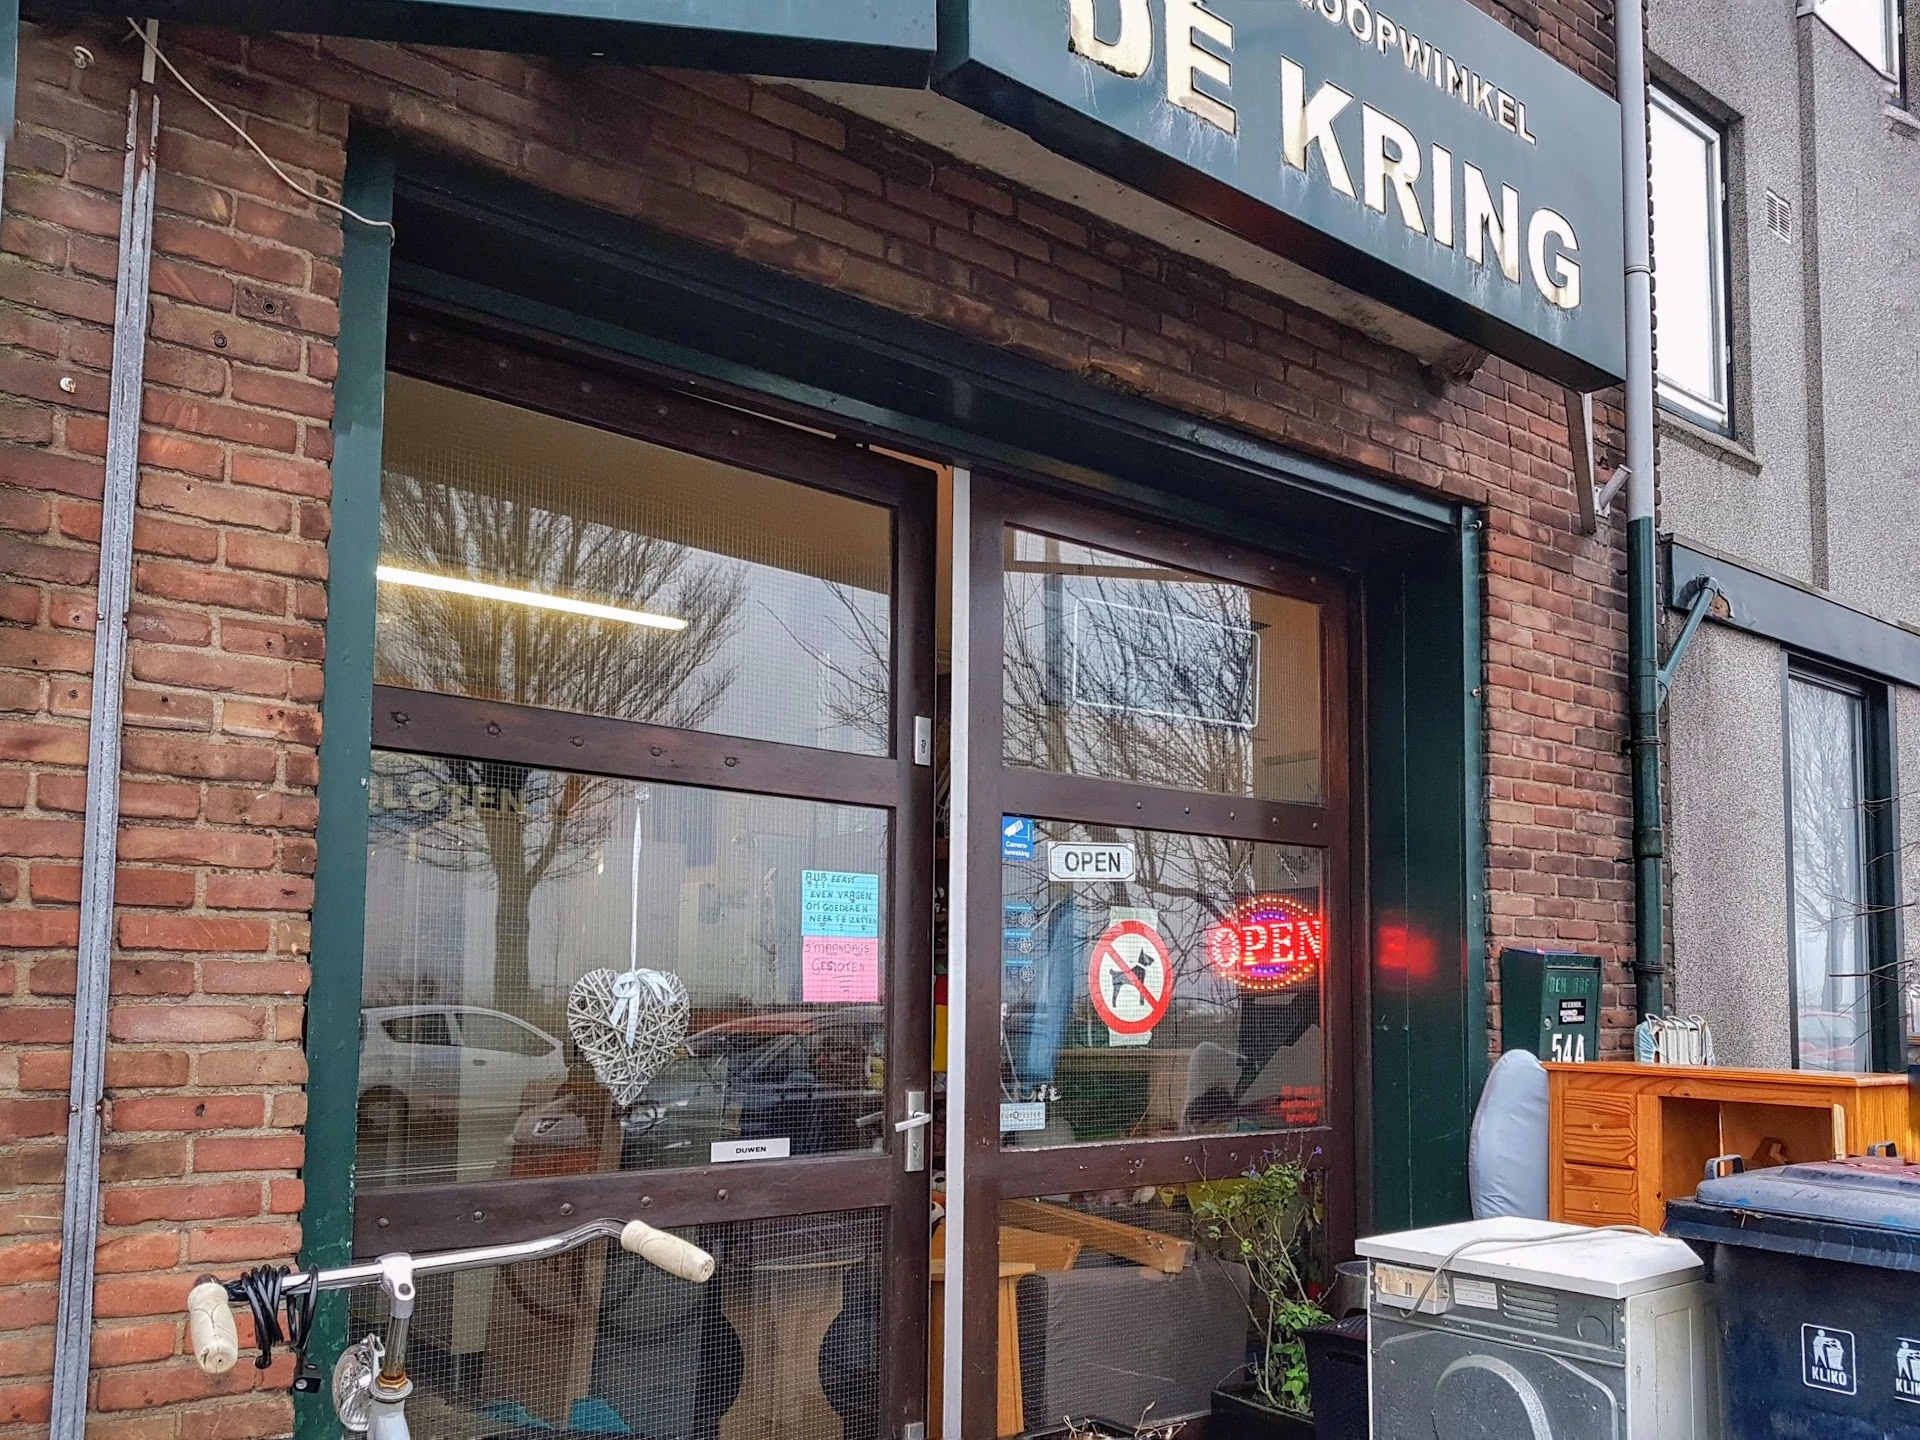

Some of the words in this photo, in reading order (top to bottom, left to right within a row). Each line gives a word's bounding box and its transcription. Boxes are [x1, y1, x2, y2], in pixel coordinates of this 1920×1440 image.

[1296, 0, 1537, 146] OOPWINKEL
[1280, 54, 1582, 310] KRING
[1064, 851, 1121, 872] OPEN
[831, 876, 857, 884] EERST
[810, 890, 834, 898] EVEN
[838, 890, 872, 900] VRAGEN
[805, 902, 820, 911] OM
[822, 903, 868, 913] GOEDEREN
[835, 914, 846, 923] TE
[849, 916, 877, 925] ZETTEN
[1212, 920, 1322, 968] OPEN
[811, 957, 865, 975] GESLOTEN
[1551, 1033, 1585, 1063] 54A
[735, 1146, 767, 1154] DUWEN
[1811, 1366, 1847, 1386] KLIKO
